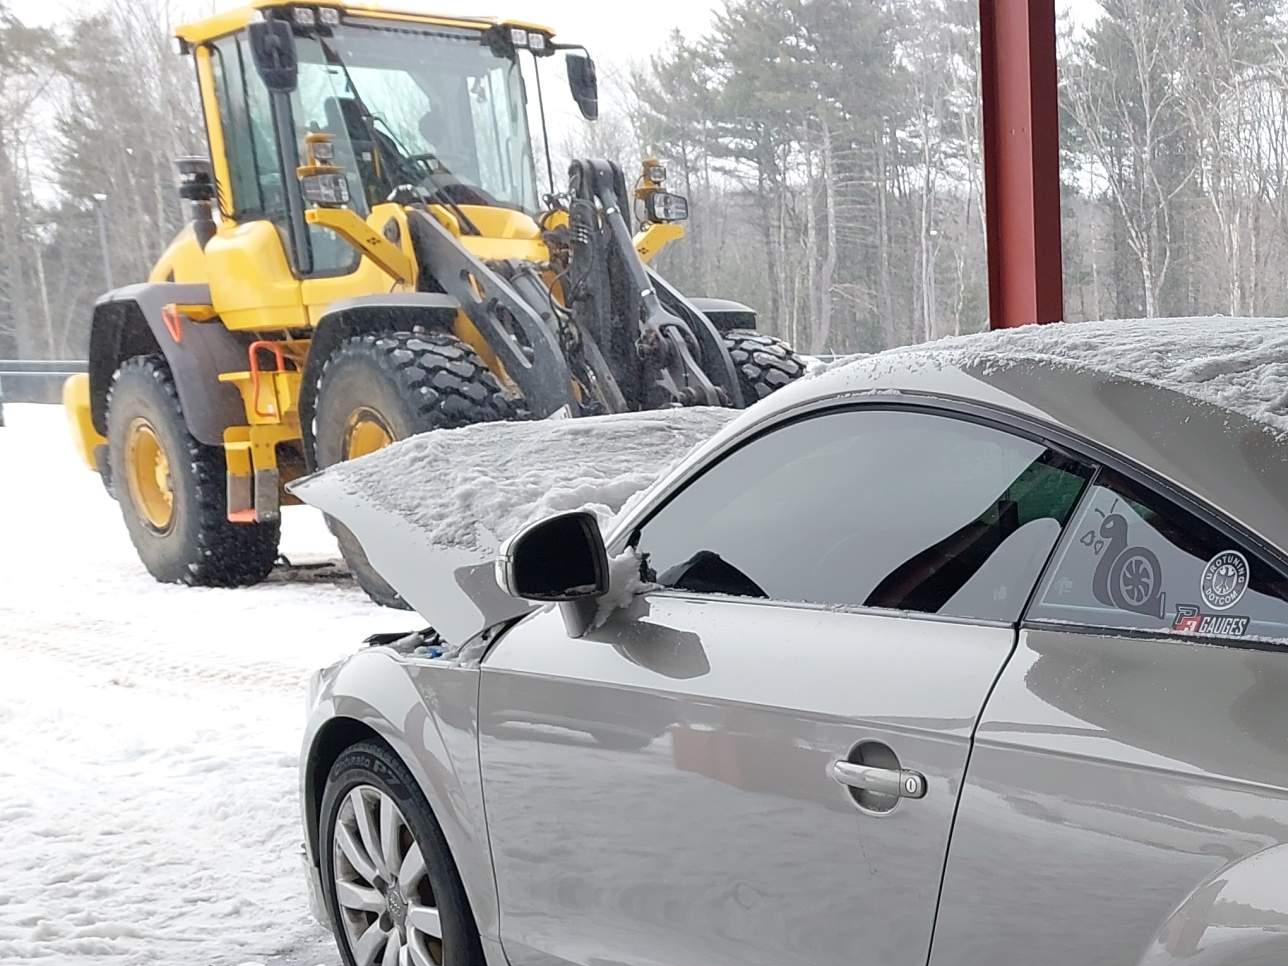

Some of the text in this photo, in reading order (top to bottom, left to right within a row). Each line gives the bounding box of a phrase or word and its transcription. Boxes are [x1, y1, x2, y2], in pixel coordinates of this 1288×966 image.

[1205, 554, 1245, 583] UROTUNING
[1205, 587, 1239, 606] DOTCOM
[1199, 616, 1247, 635] GAUGES
[373, 759, 401, 785] P7
